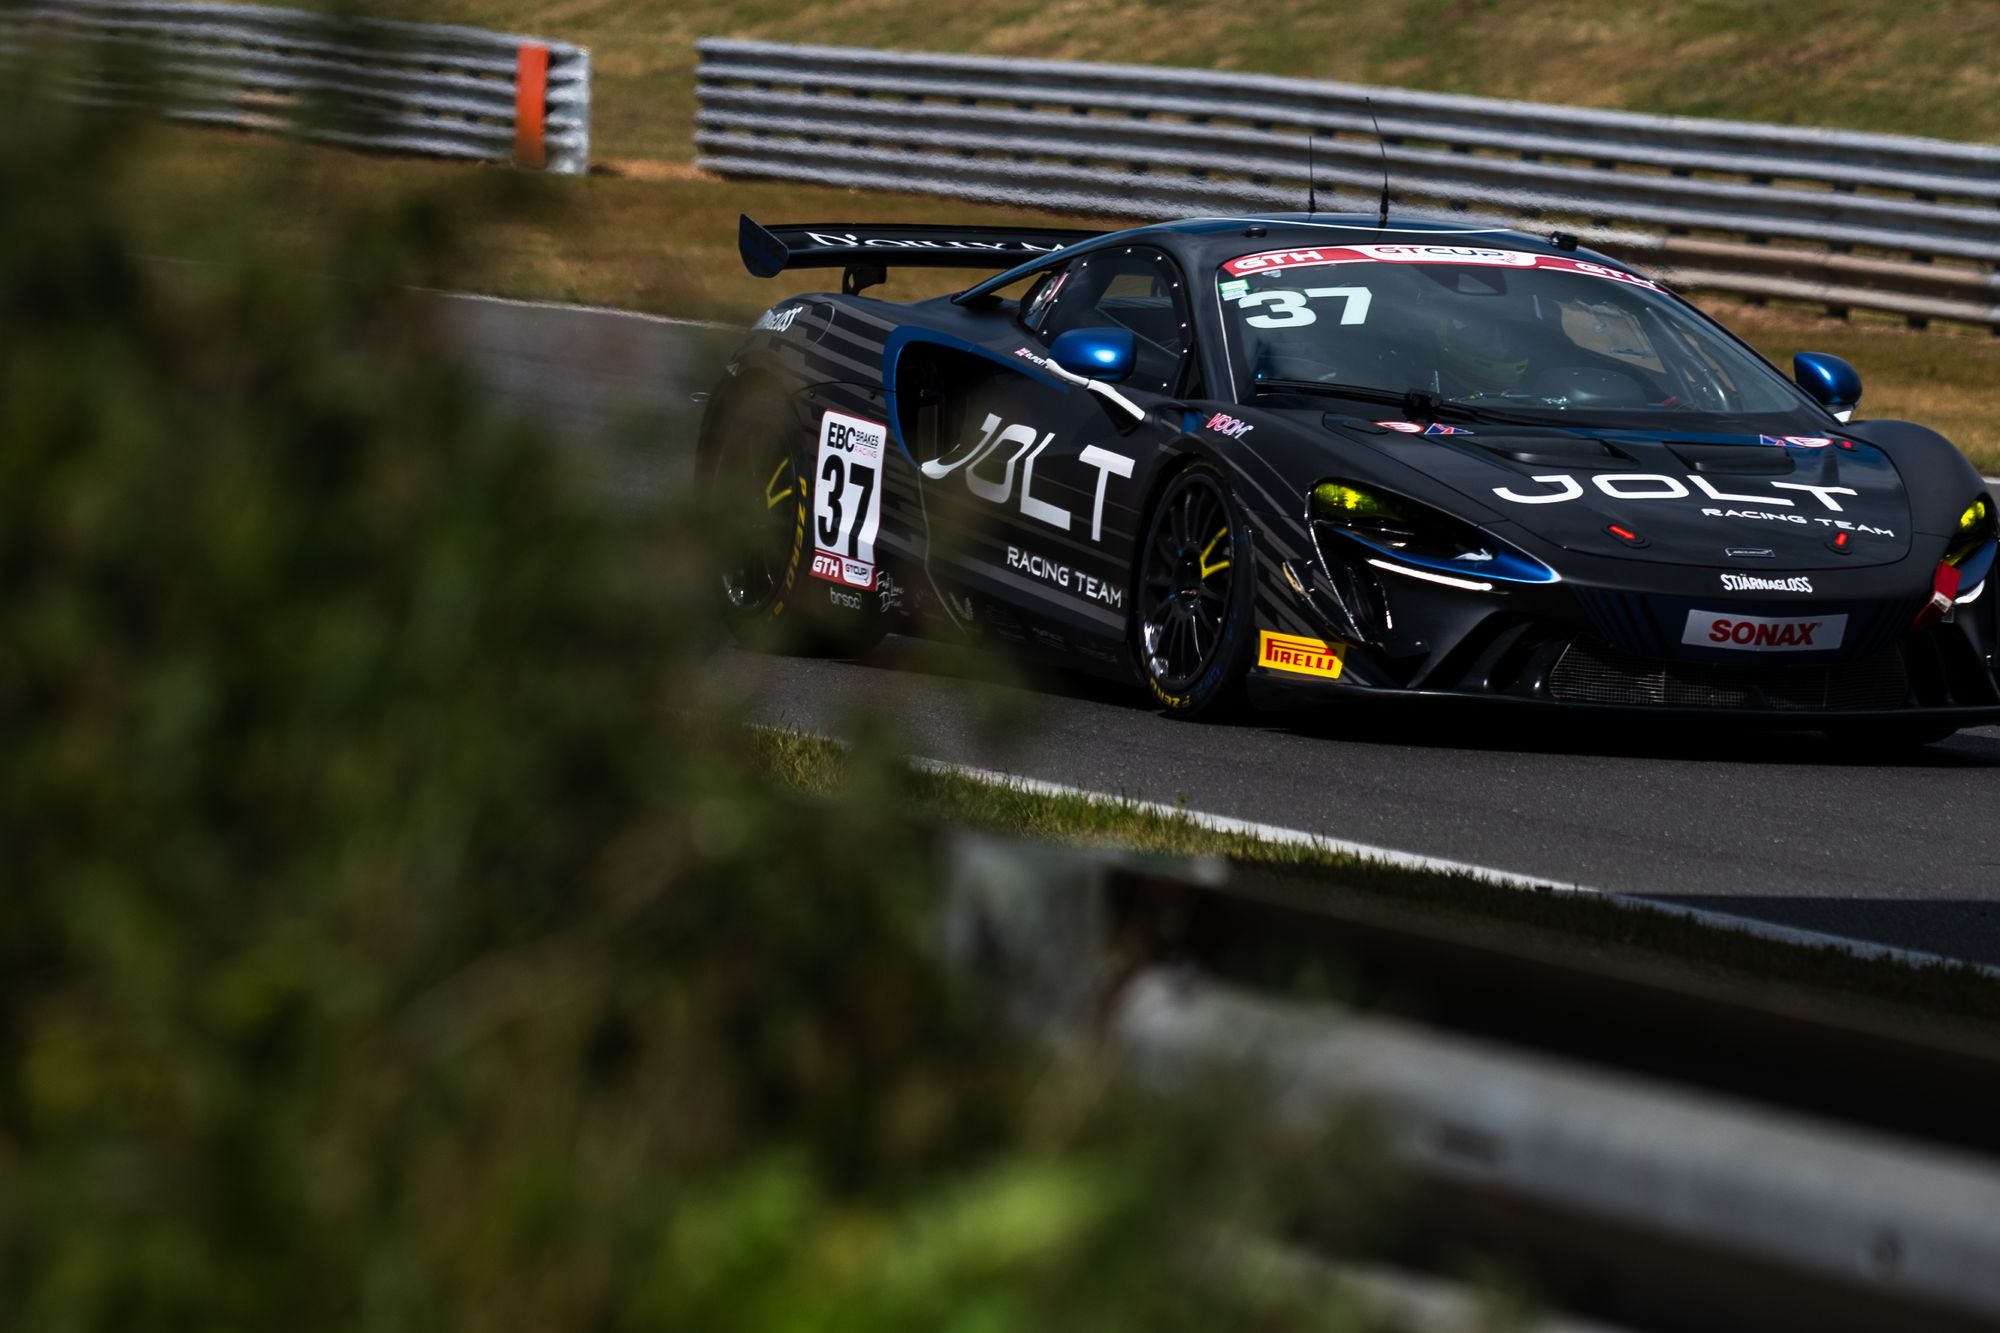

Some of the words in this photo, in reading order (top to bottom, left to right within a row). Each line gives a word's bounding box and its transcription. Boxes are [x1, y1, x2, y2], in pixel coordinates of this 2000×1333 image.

[1234, 251, 1324, 269] GTH
[1238, 286, 1372, 328] 37
[827, 421, 855, 452] EBC
[855, 430, 879, 446] BRAKES
[921, 413, 1135, 541] JOLT
[1493, 474, 1857, 512] JOLT
[818, 454, 875, 560] 37
[1701, 508, 1808, 524] RACING
[1814, 518, 1895, 538] TEAM
[812, 555, 840, 578] GTH
[1006, 546, 1069, 587] RACING
[1075, 572, 1122, 608] TEAM
[1720, 573, 1813, 593] STJÄRNAGLOSS
[1708, 619, 1815, 647] SONAX
[1265, 637, 1336, 671] PIRELLI
